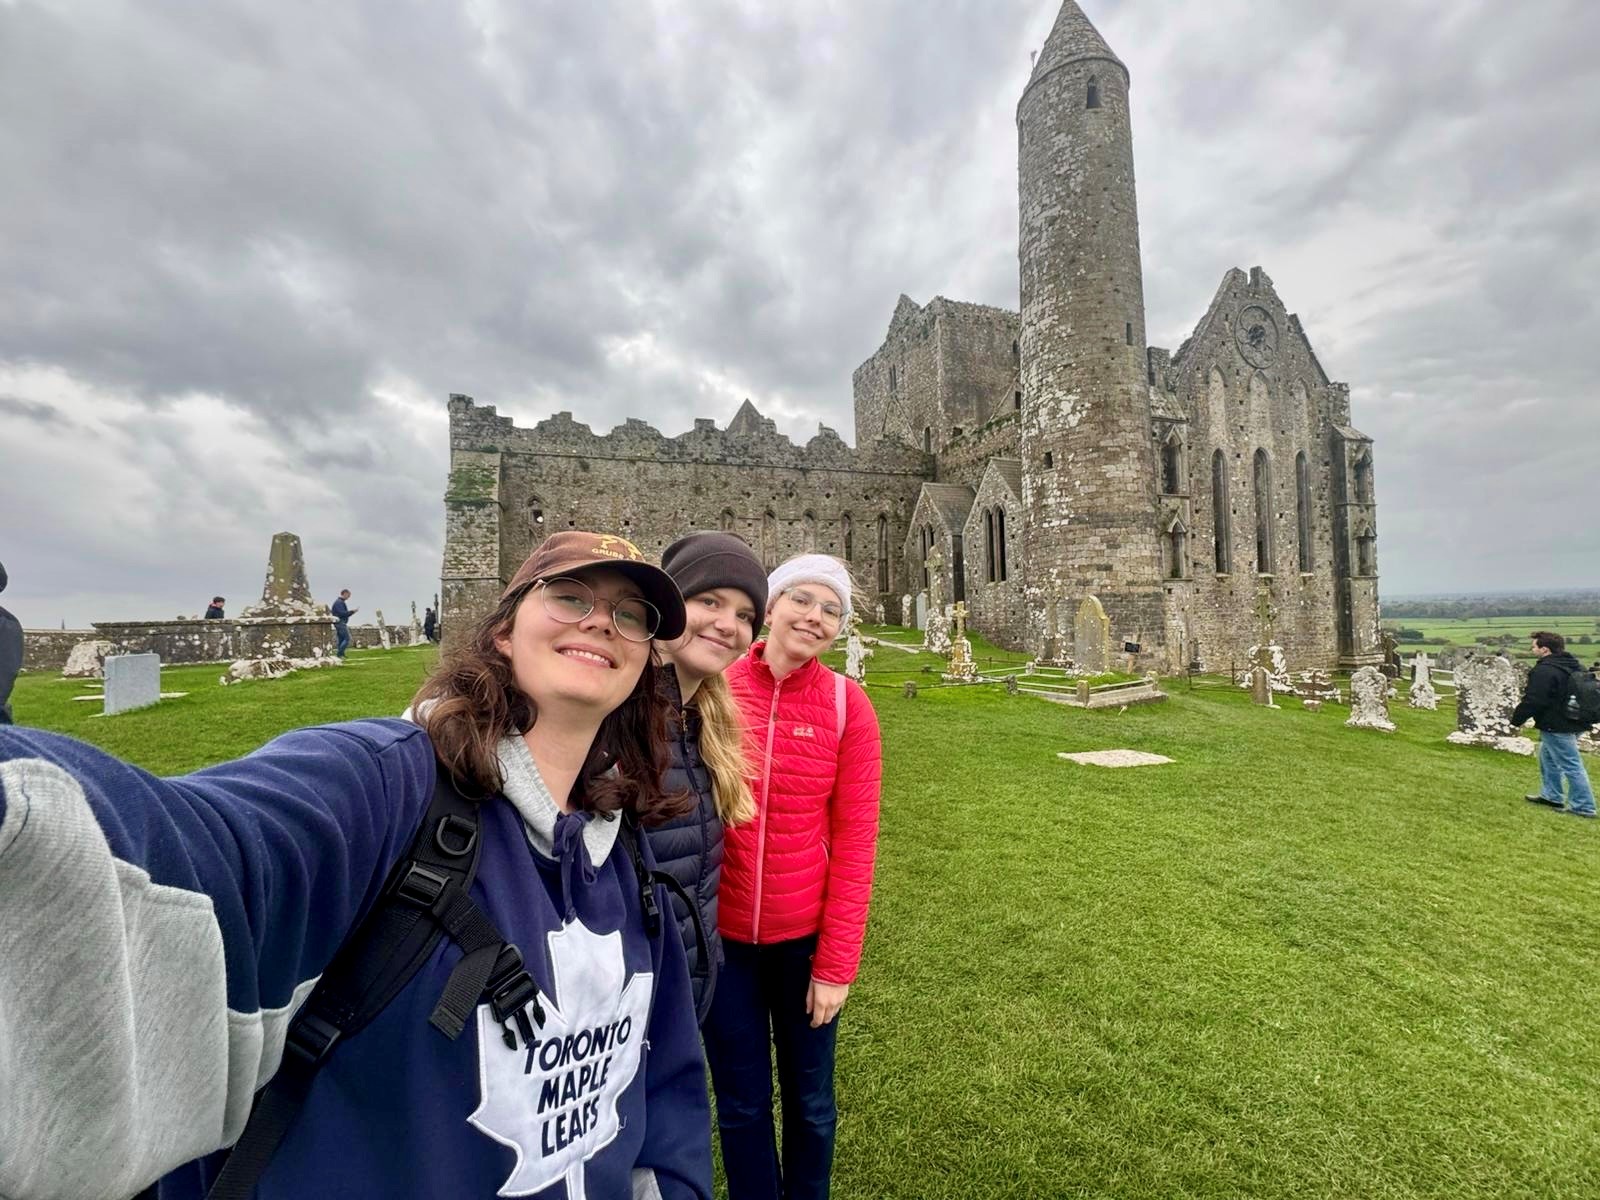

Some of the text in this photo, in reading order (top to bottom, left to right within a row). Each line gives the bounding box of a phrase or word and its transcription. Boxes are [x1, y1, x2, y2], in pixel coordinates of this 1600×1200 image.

[524, 1015, 632, 1075] TORONTO
[537, 1056, 613, 1115] MAPLE
[541, 1095, 600, 1158] LEAFS
